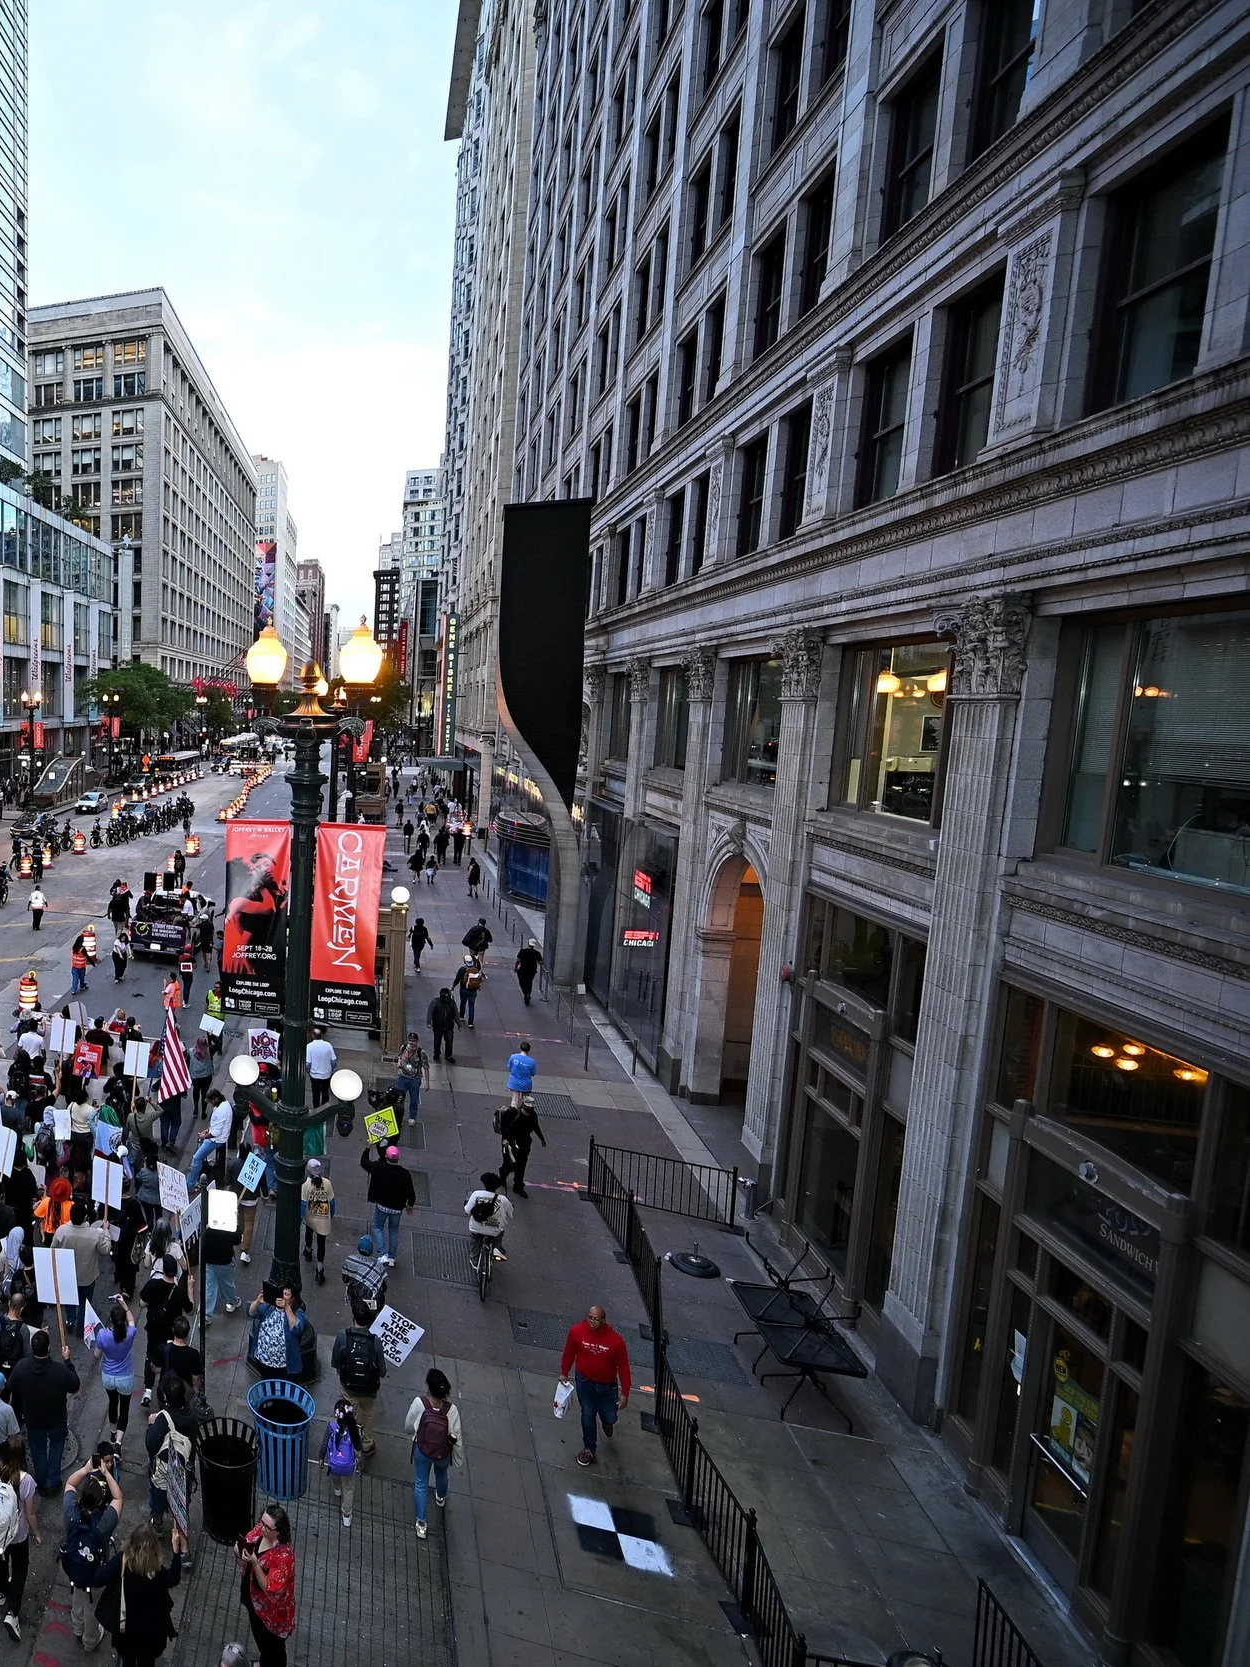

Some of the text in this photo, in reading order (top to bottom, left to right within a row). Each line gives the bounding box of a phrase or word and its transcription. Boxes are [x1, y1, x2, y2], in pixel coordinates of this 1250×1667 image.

[32, 638, 40, 681] Walgreens
[65, 644, 73, 683] Walgreens
[447, 618, 457, 699] GENE SISKEL
[326, 831, 363, 972] CARMEN
[231, 953, 277, 961] JOFFREY.ORG
[229, 986, 277, 997] LoopChicago.com
[318, 995, 369, 1006] LoopChicago.com
[251, 1035, 277, 1051] NOT
[251, 1049, 277, 1059] GREAT
[251, 1159, 260, 1168] ICE
[1100, 1224, 1153, 1272] SANDWICH
[390, 1312, 417, 1331] STOP
[391, 1319, 410, 1336] THE
[381, 1322, 410, 1344] RAIDS
[381, 1332, 400, 1347] ICE
[390, 1346, 403, 1356] OF
